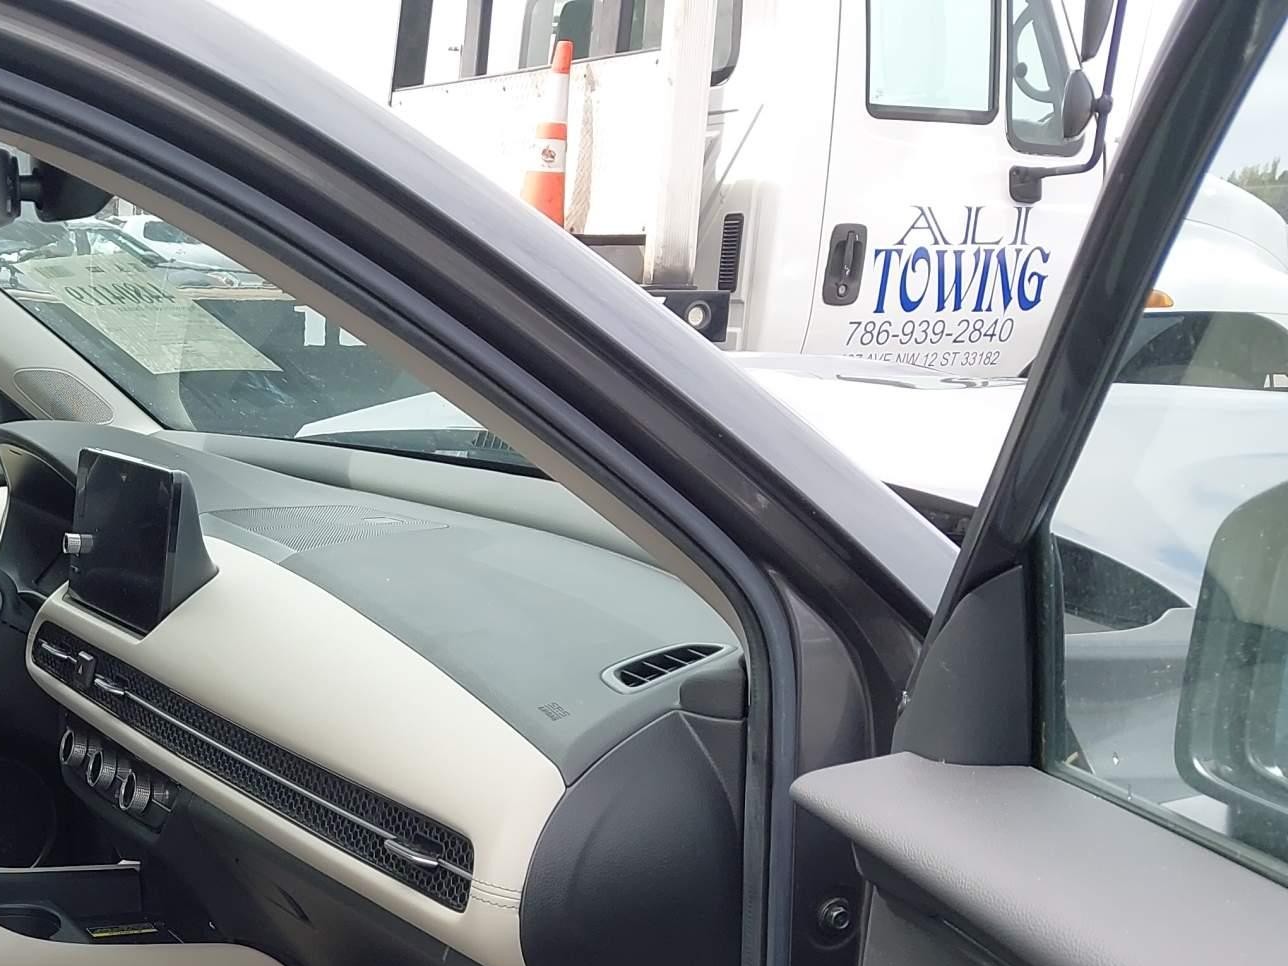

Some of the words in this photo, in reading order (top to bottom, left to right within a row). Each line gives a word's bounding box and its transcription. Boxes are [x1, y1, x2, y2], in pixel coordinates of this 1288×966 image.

[893, 205, 1035, 246] ALI
[873, 246, 1051, 316] TOWING
[845, 317, 1015, 346] 786-939-2840
[923, 352, 938, 366] 12
[940, 351, 960, 367] ST
[961, 350, 1000, 366] 33182
